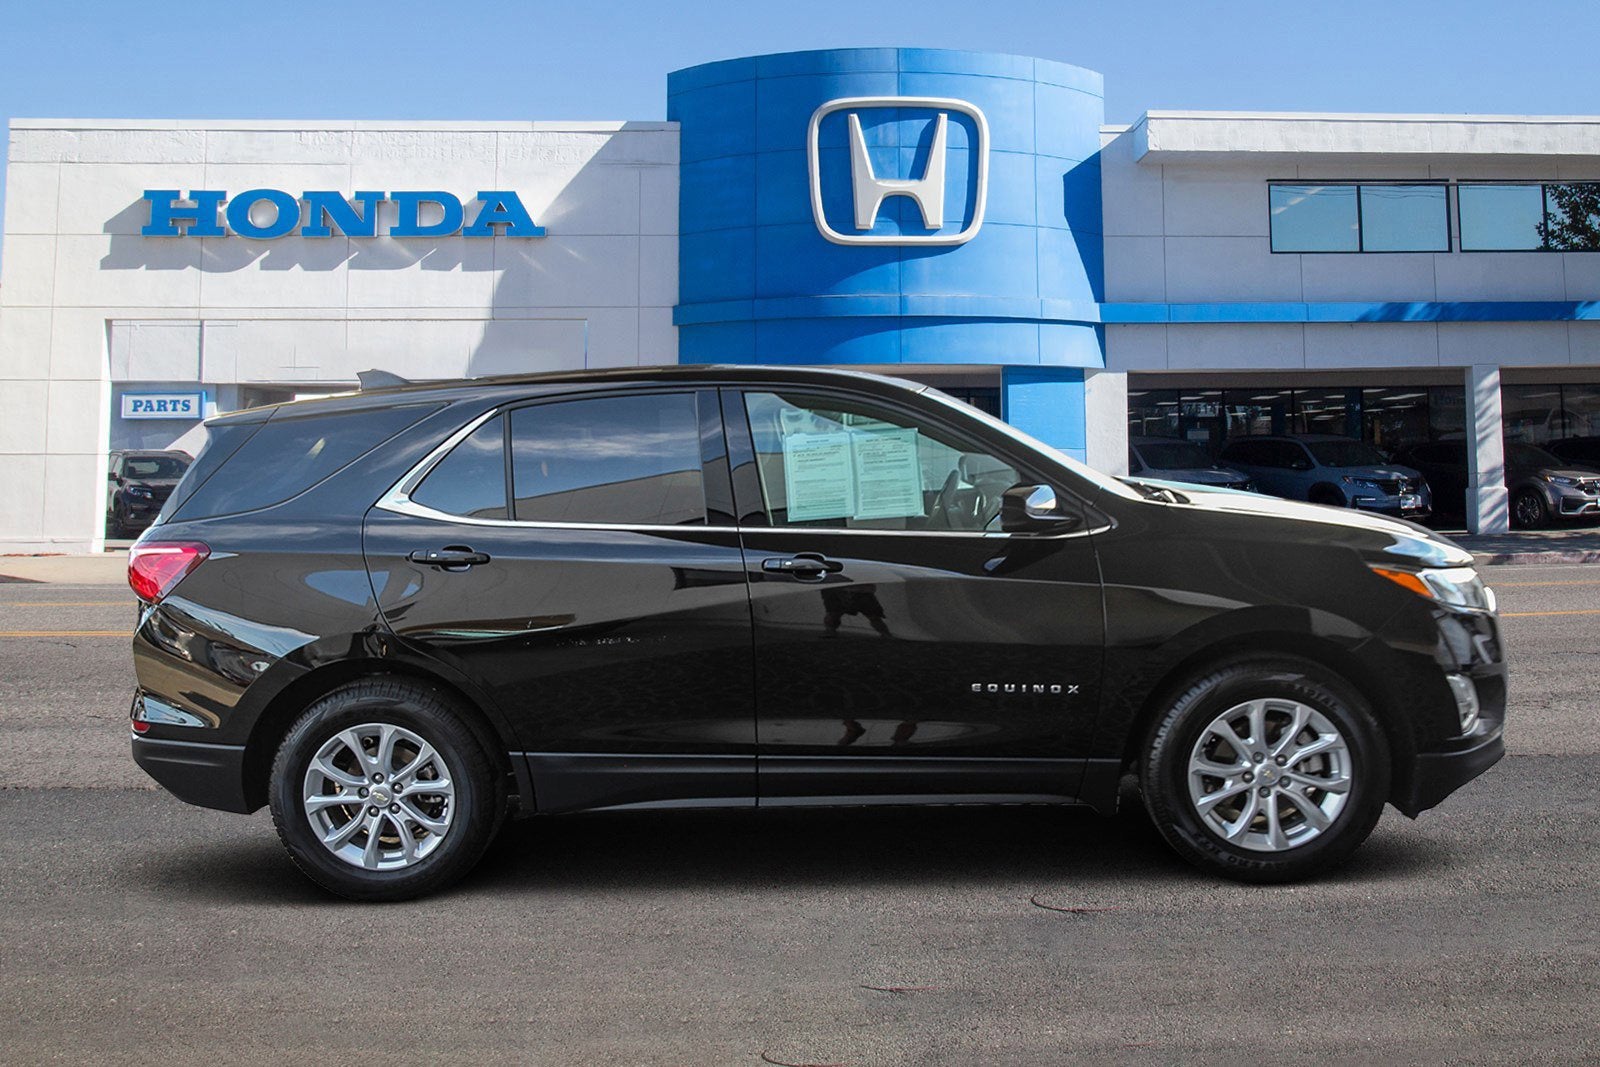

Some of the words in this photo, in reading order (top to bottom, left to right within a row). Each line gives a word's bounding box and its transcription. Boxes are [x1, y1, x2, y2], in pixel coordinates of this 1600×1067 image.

[141, 188, 547, 239] HONDA
[132, 400, 191, 412] PARTS
[971, 683, 1079, 694] EQUINOX
